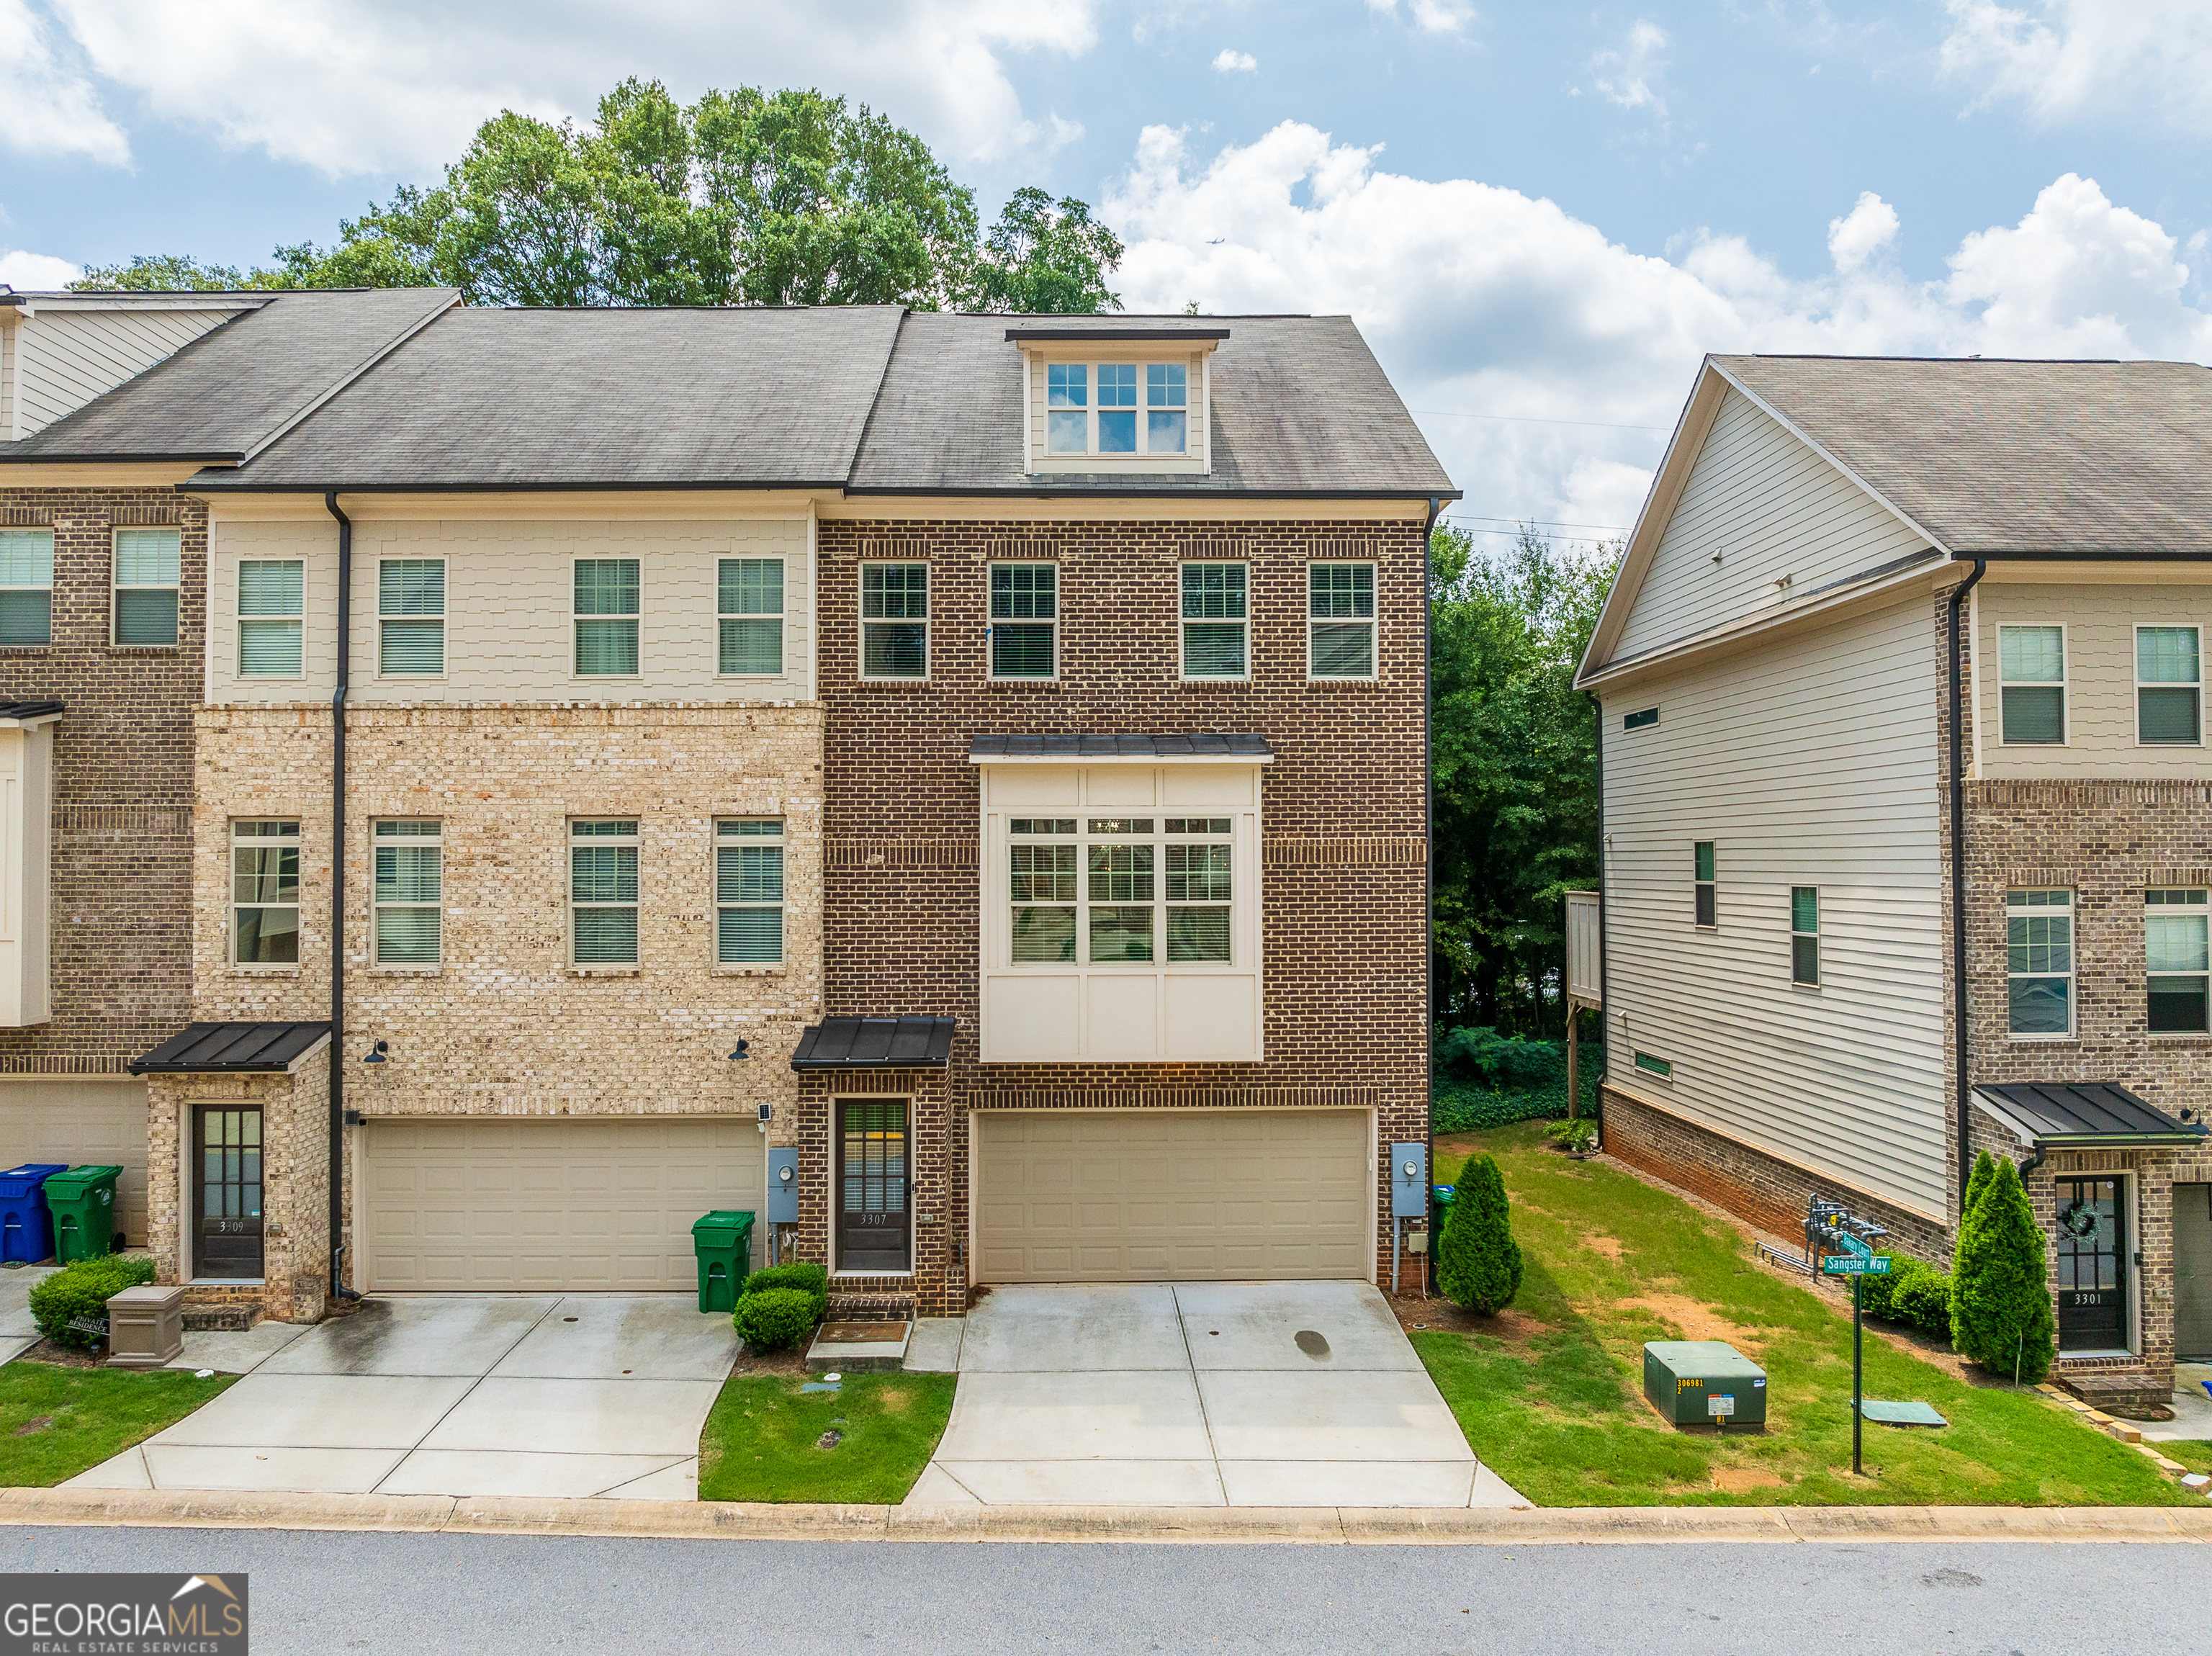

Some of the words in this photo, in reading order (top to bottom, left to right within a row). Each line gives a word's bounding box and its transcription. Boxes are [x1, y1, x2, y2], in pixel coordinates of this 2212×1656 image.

[860, 1214, 886, 1225] 3307
[220, 1221, 243, 1232] 3309
[1858, 1242, 1870, 1259] Court
[1828, 1257, 1866, 1272] Sangster
[1870, 1258, 1887, 1272] Way
[2075, 1293, 2100, 1305] 3301
[68, 1319, 107, 1333] RESIDENCE
[76, 1315, 104, 1326] PRIVATE
